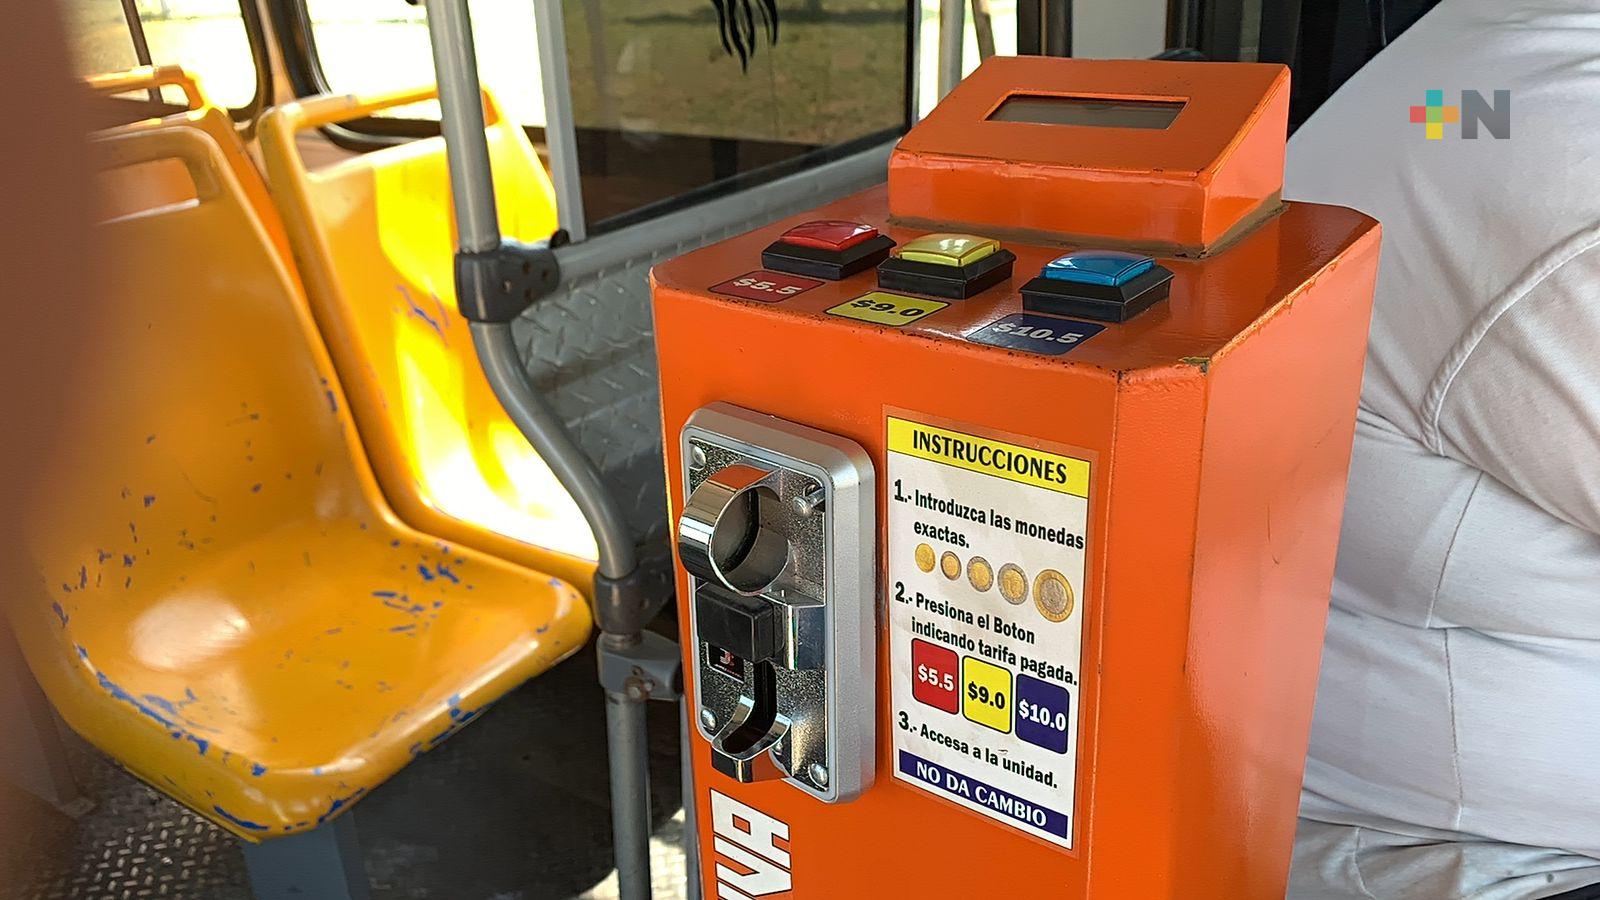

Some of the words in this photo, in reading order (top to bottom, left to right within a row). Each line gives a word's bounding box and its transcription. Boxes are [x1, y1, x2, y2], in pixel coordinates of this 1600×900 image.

[733, 278, 802, 295] $5.5
[850, 300, 925, 316] $9.0
[992, 323, 1084, 343] $10.5
[913, 429, 1067, 484] INSTRUCCIONES
[914, 521, 970, 548] exactas.
[915, 489, 986, 524] Introduzca
[990, 509, 1011, 531] las
[1015, 519, 1084, 550] monedas
[916, 593, 973, 625] Presiona
[977, 614, 989, 630] el
[994, 617, 1035, 644] Boton
[912, 617, 975, 651] indicando
[979, 639, 1016, 665] tarifa
[1021, 658, 1077, 686] pagada.
[918, 664, 954, 692] $5.5
[968, 681, 1005, 709] $9.0
[1018, 699, 1066, 731] $10.0
[920, 724, 969, 754] Accesa
[973, 744, 981, 759] a
[985, 748, 998, 766] la
[1003, 757, 1057, 788] unidad.
[916, 761, 941, 784] NO
[946, 776, 970, 798] DA
[975, 786, 1047, 827] CAMBIO
